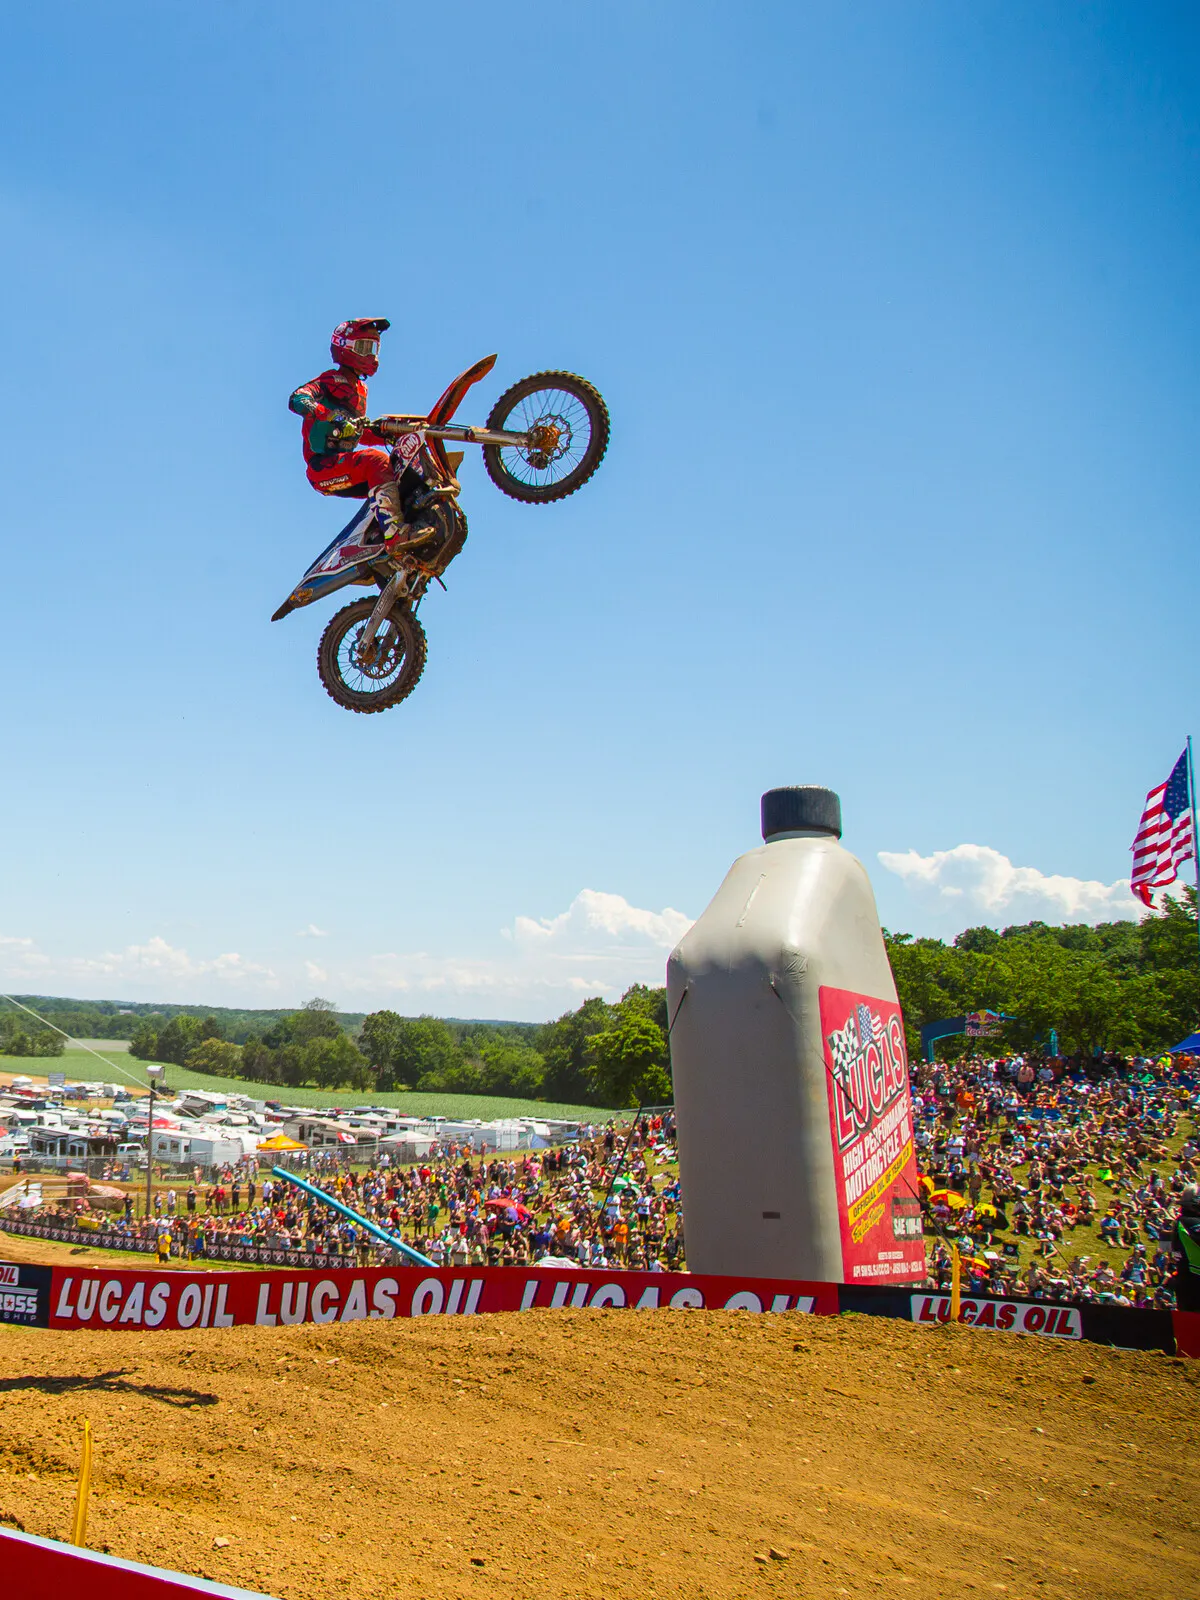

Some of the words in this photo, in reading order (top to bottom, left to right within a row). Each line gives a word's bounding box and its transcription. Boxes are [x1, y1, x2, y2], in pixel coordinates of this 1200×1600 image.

[834, 1014, 906, 1147] LUCAS
[843, 1141, 864, 1178] HIGH
[845, 1128, 900, 1206] MOTORCYCLE
[55, 1278, 171, 1327] LUCAS
[177, 1283, 235, 1328] OIL
[255, 1278, 401, 1327] LUCAS
[410, 1278, 487, 1317] OIL
[918, 1297, 1018, 1331] LUCAS
[1023, 1307, 1074, 1335] OIL
